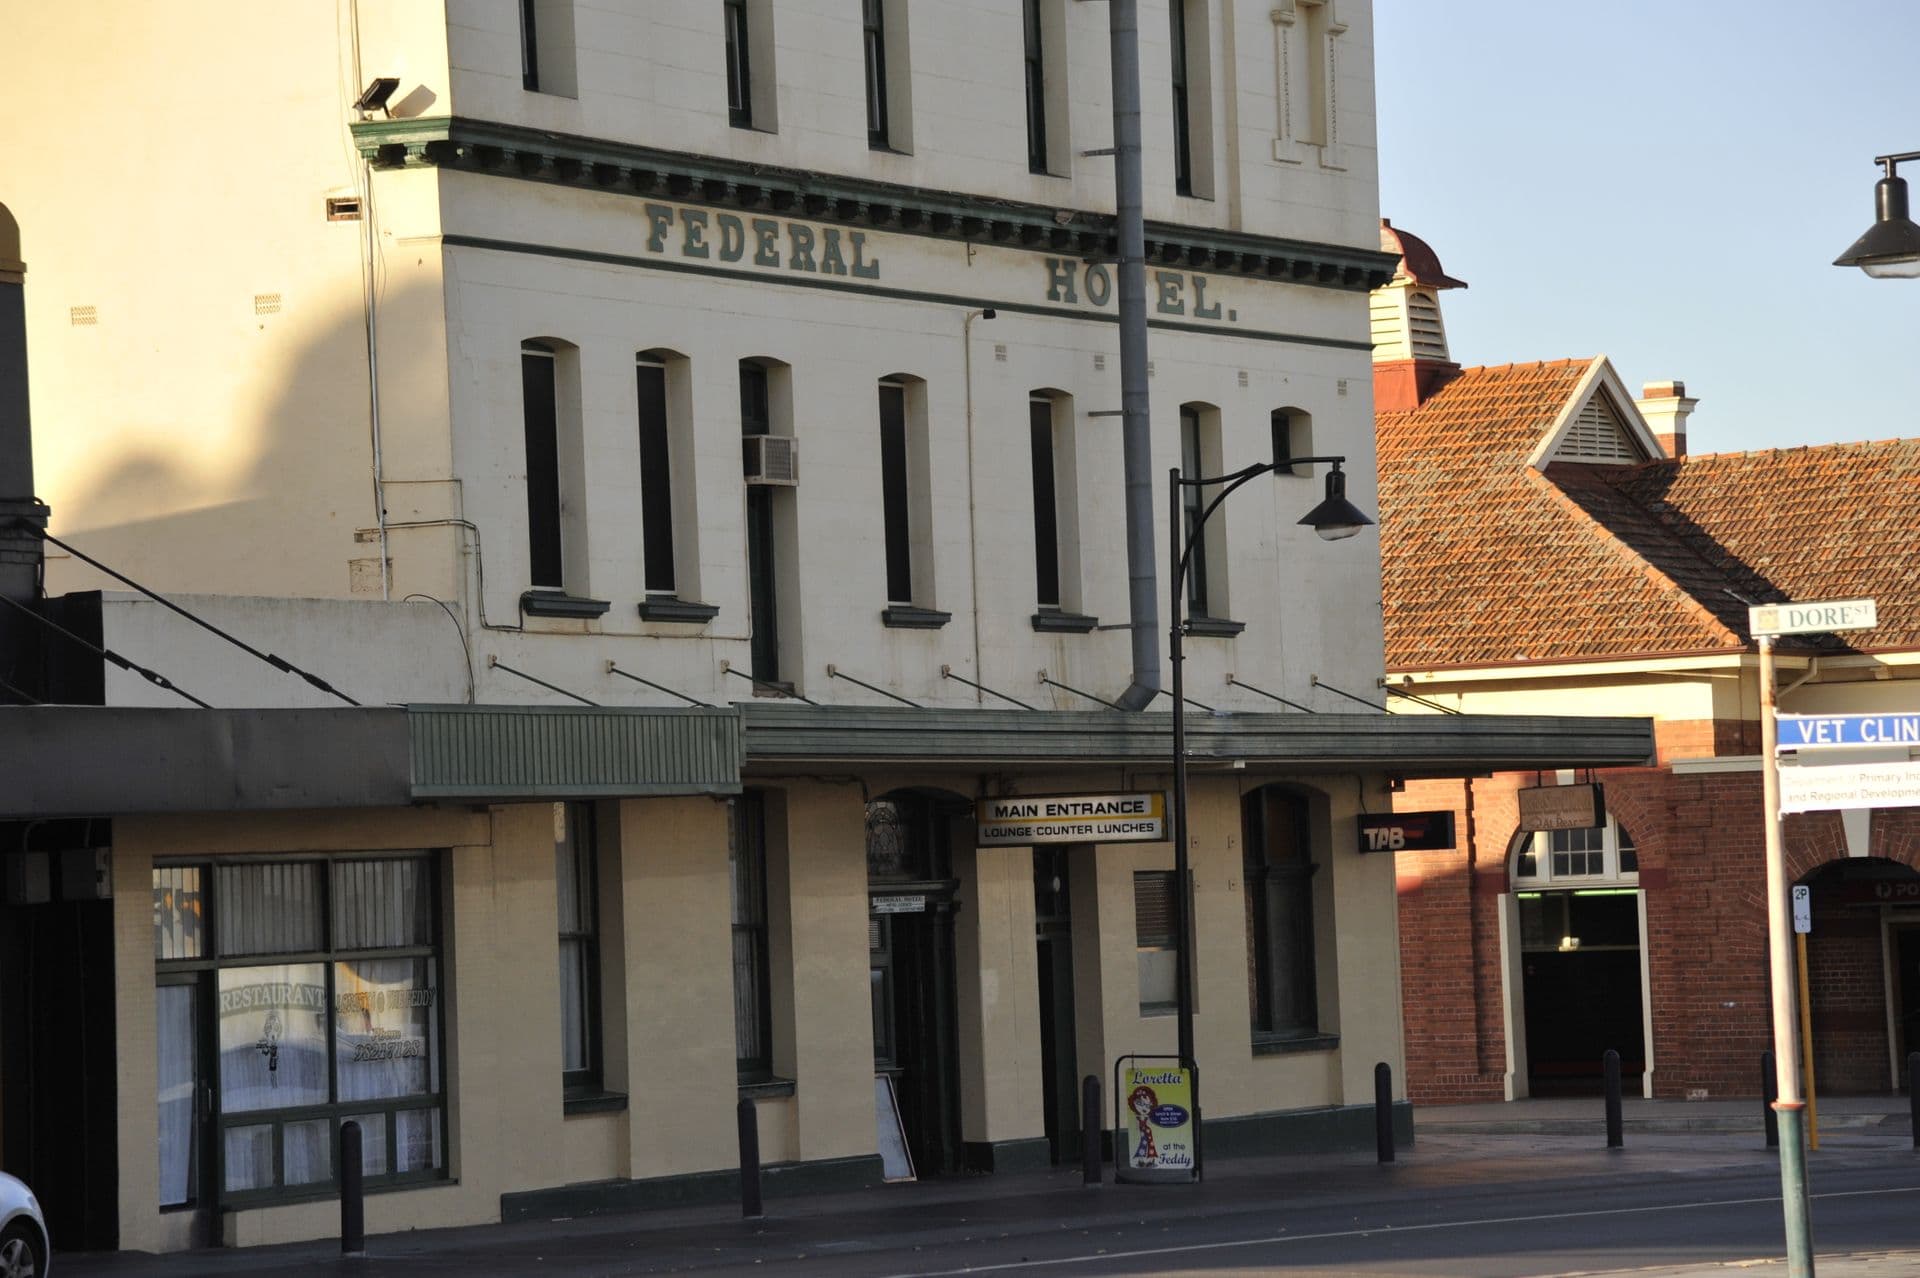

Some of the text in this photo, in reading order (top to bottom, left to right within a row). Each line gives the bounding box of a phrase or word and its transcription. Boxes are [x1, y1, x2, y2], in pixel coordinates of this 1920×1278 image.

[644, 202, 1237, 321] FEDERAL HOEL.
[1789, 605, 1869, 628] DORE ST
[1797, 717, 1920, 743] VET CLIN
[1858, 772, 1901, 785] Primary
[1810, 791, 1857, 804] Regional
[995, 800, 1145, 818] MAIN ENTRANCE
[1097, 821, 1155, 834] LUNCHES
[1363, 827, 1406, 850] TAB
[1795, 888, 1807, 900] 2P
[221, 985, 325, 1013] RESTAURANT
[1132, 1070, 1182, 1084] Loretta
[1173, 1142, 1185, 1150] the
[1158, 1153, 1191, 1167] Feddy
